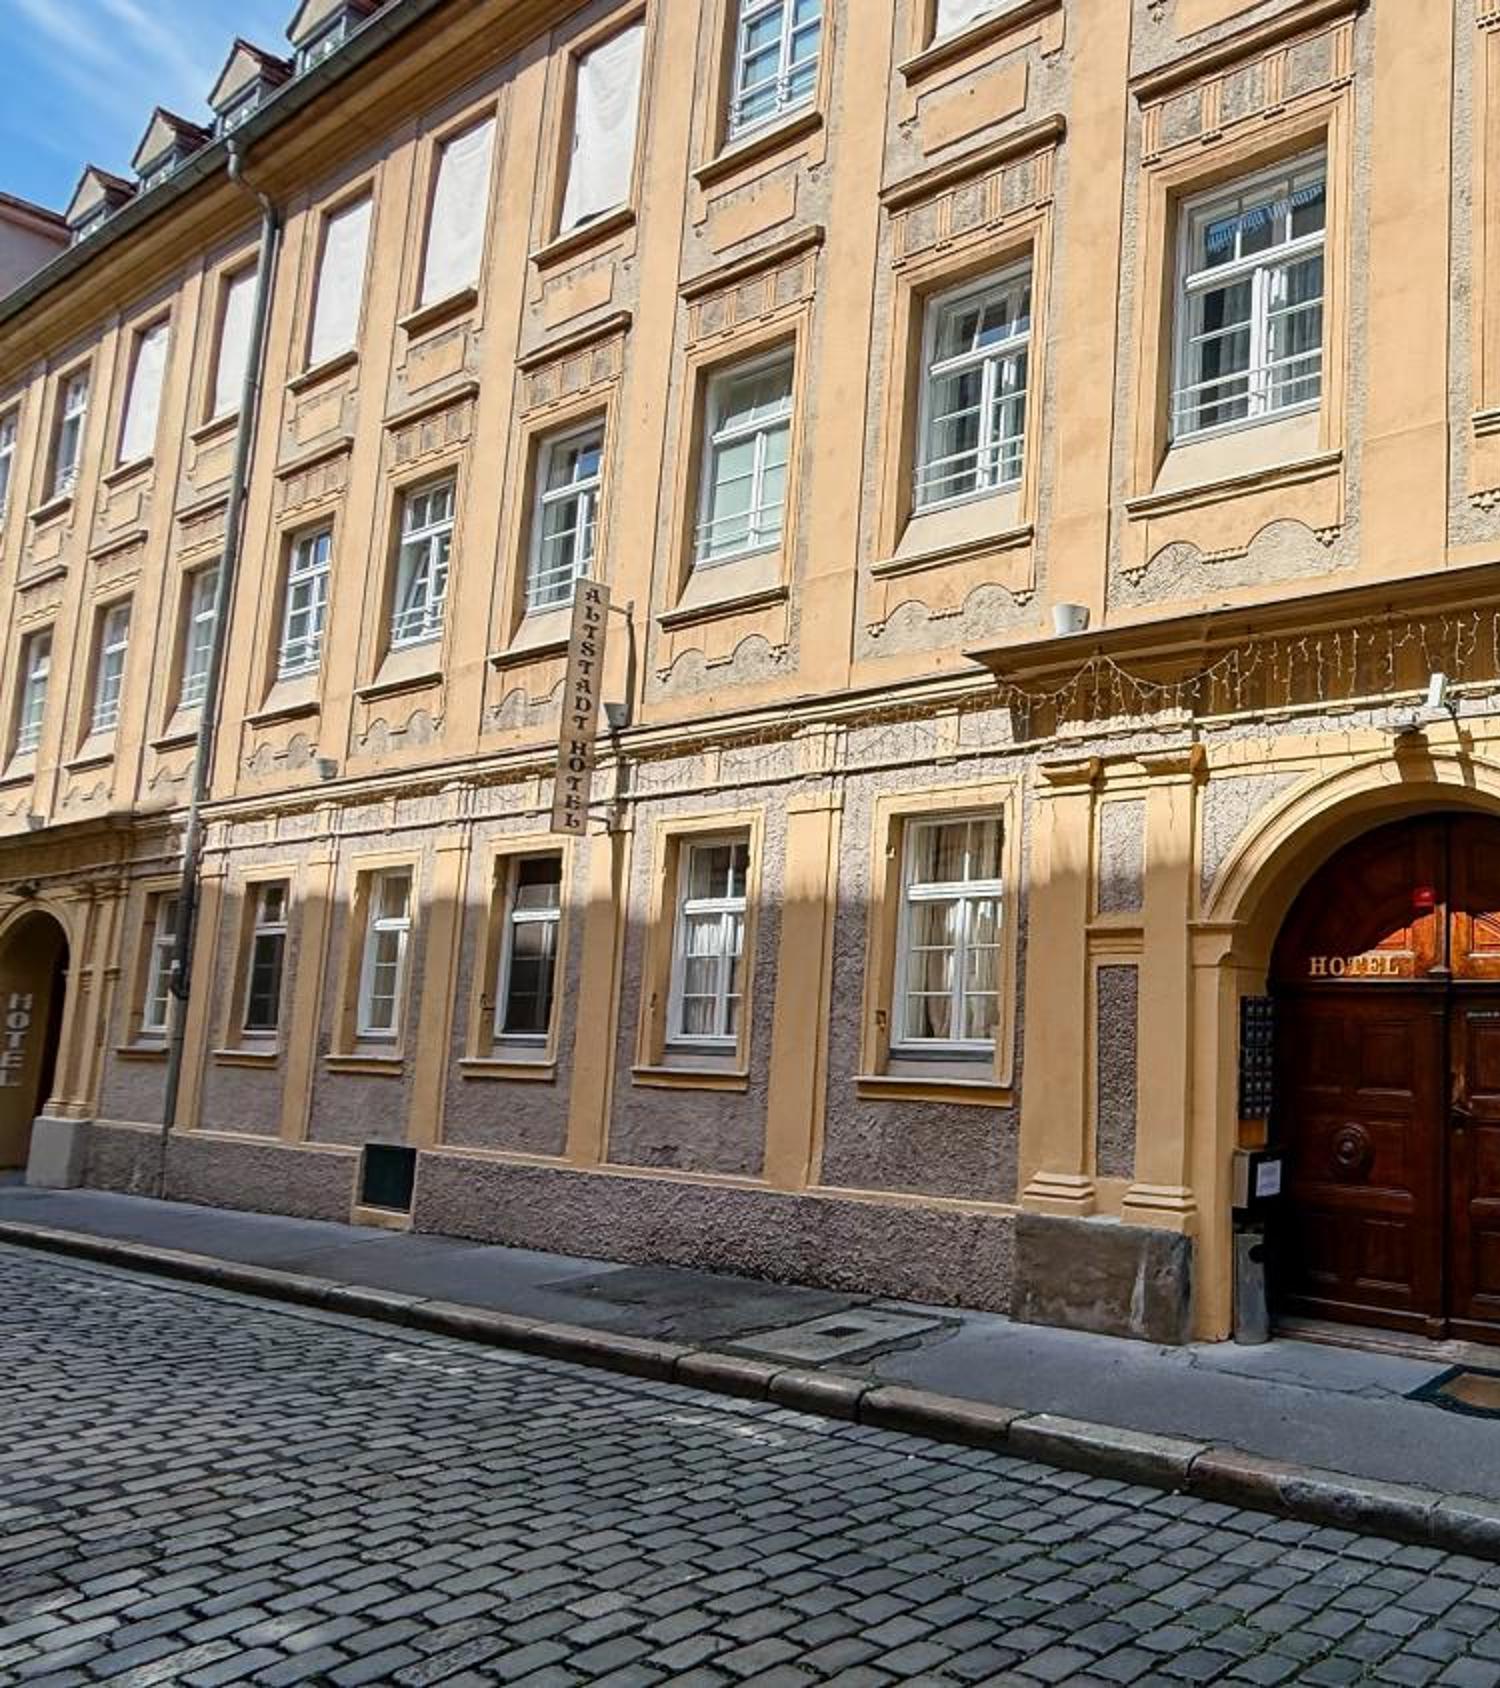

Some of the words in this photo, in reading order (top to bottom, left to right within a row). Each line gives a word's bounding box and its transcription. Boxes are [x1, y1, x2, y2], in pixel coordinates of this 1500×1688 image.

[571, 586, 602, 731] ALTSTADT
[563, 738, 588, 829] HOTEL
[1308, 955, 1399, 977] HOTEL
[0, 992, 33, 1088] HOTEL
